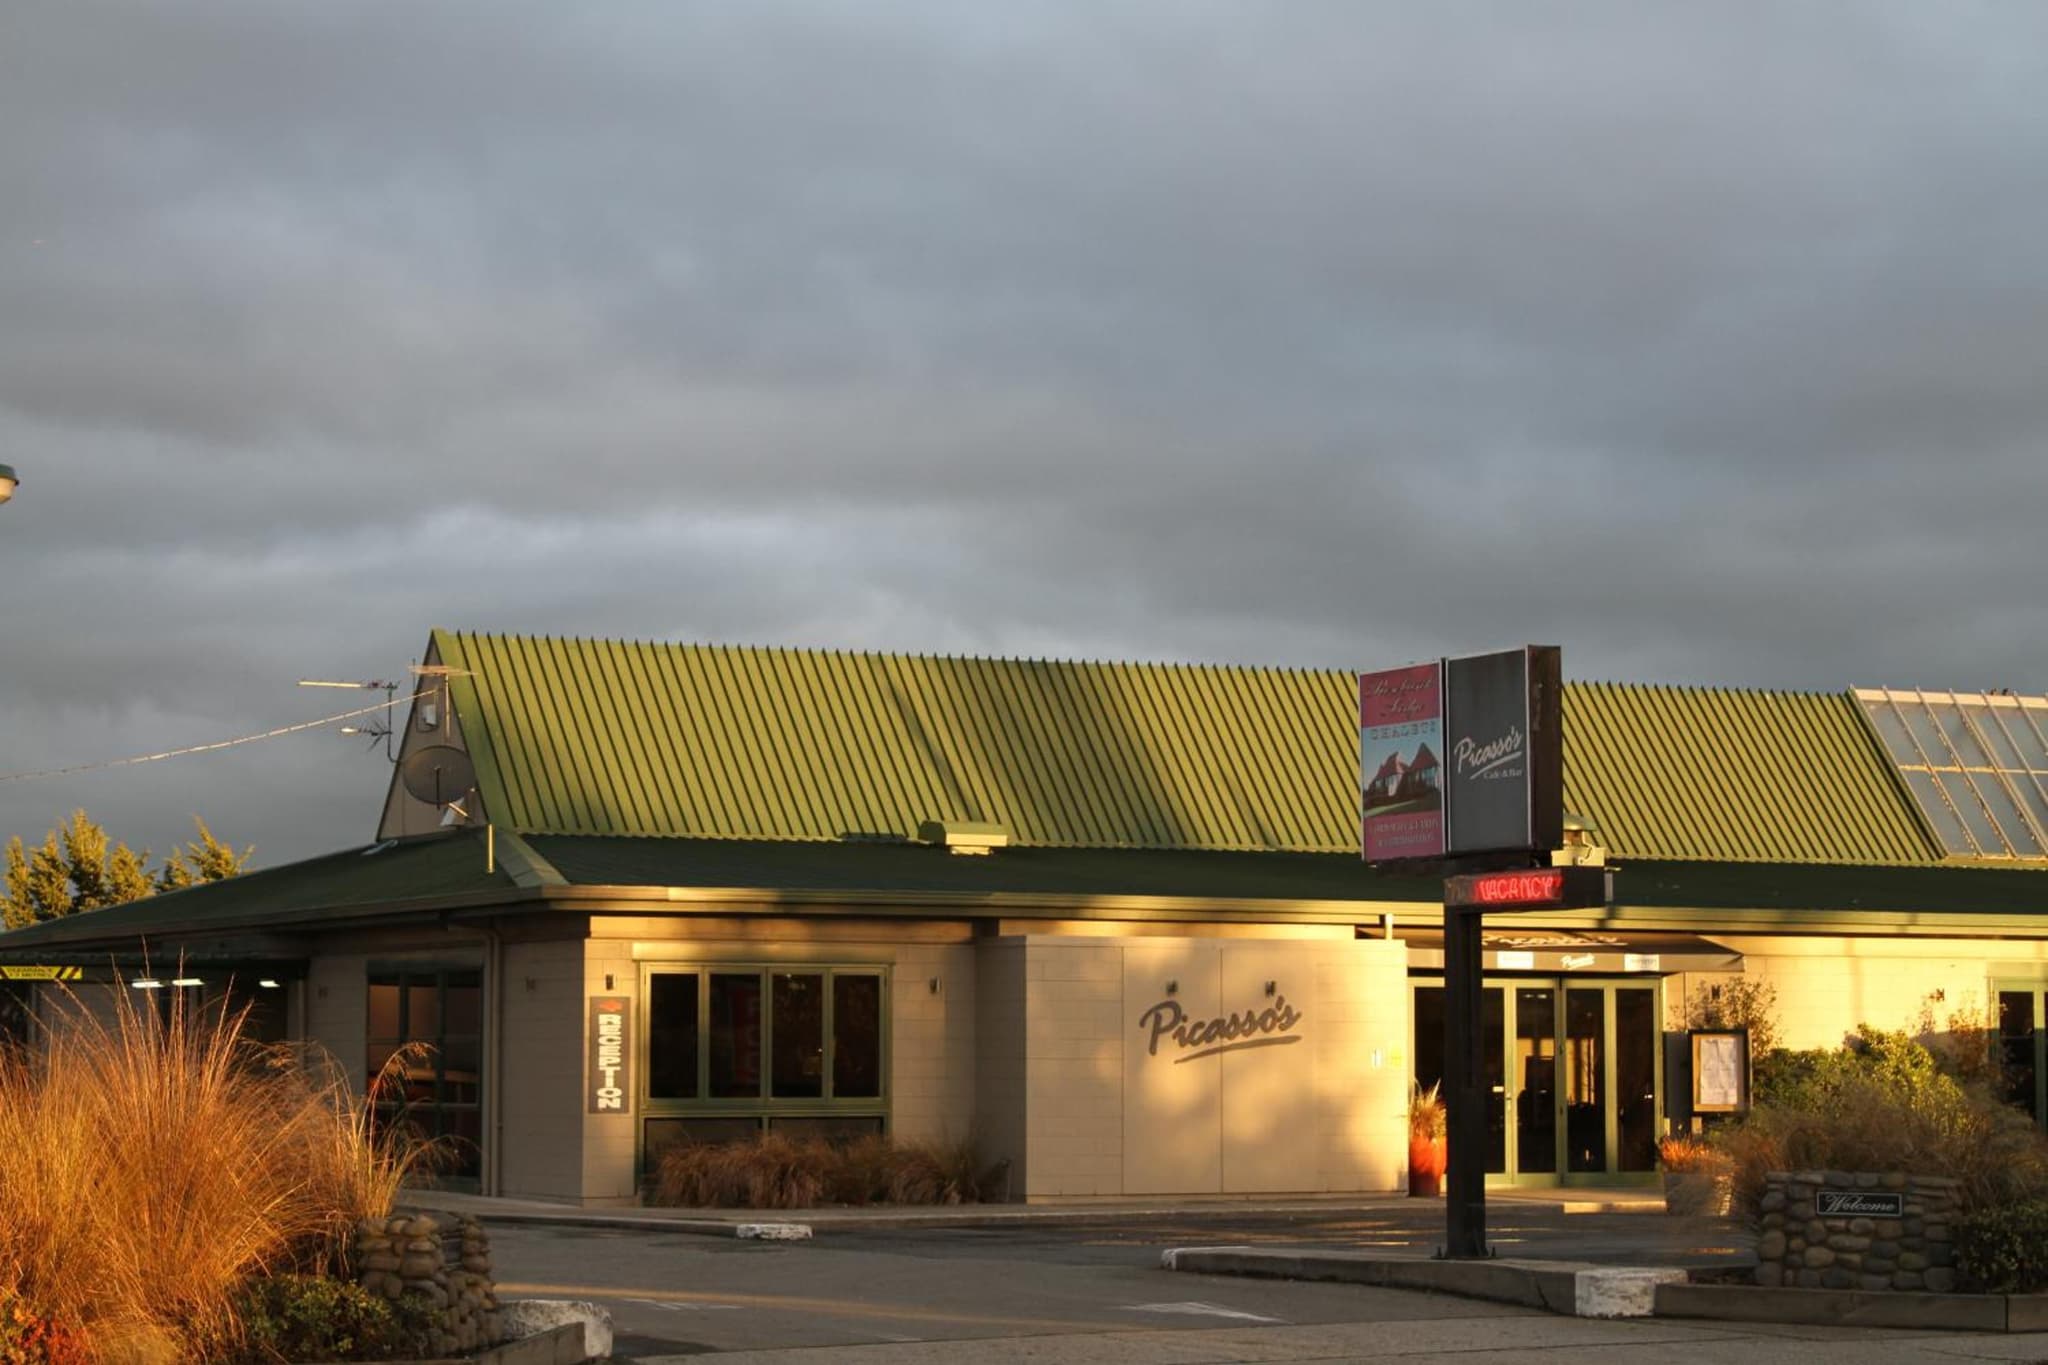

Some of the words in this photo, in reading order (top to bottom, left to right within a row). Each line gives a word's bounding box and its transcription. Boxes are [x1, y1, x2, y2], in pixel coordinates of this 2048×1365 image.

[1454, 725, 1523, 774] Picasso's
[1479, 876, 1554, 901] VACANCY
[1139, 995, 1302, 1057] Picasso's
[597, 1014, 623, 1109] RECEPTION
[1823, 1193, 1896, 1212] Welcome
